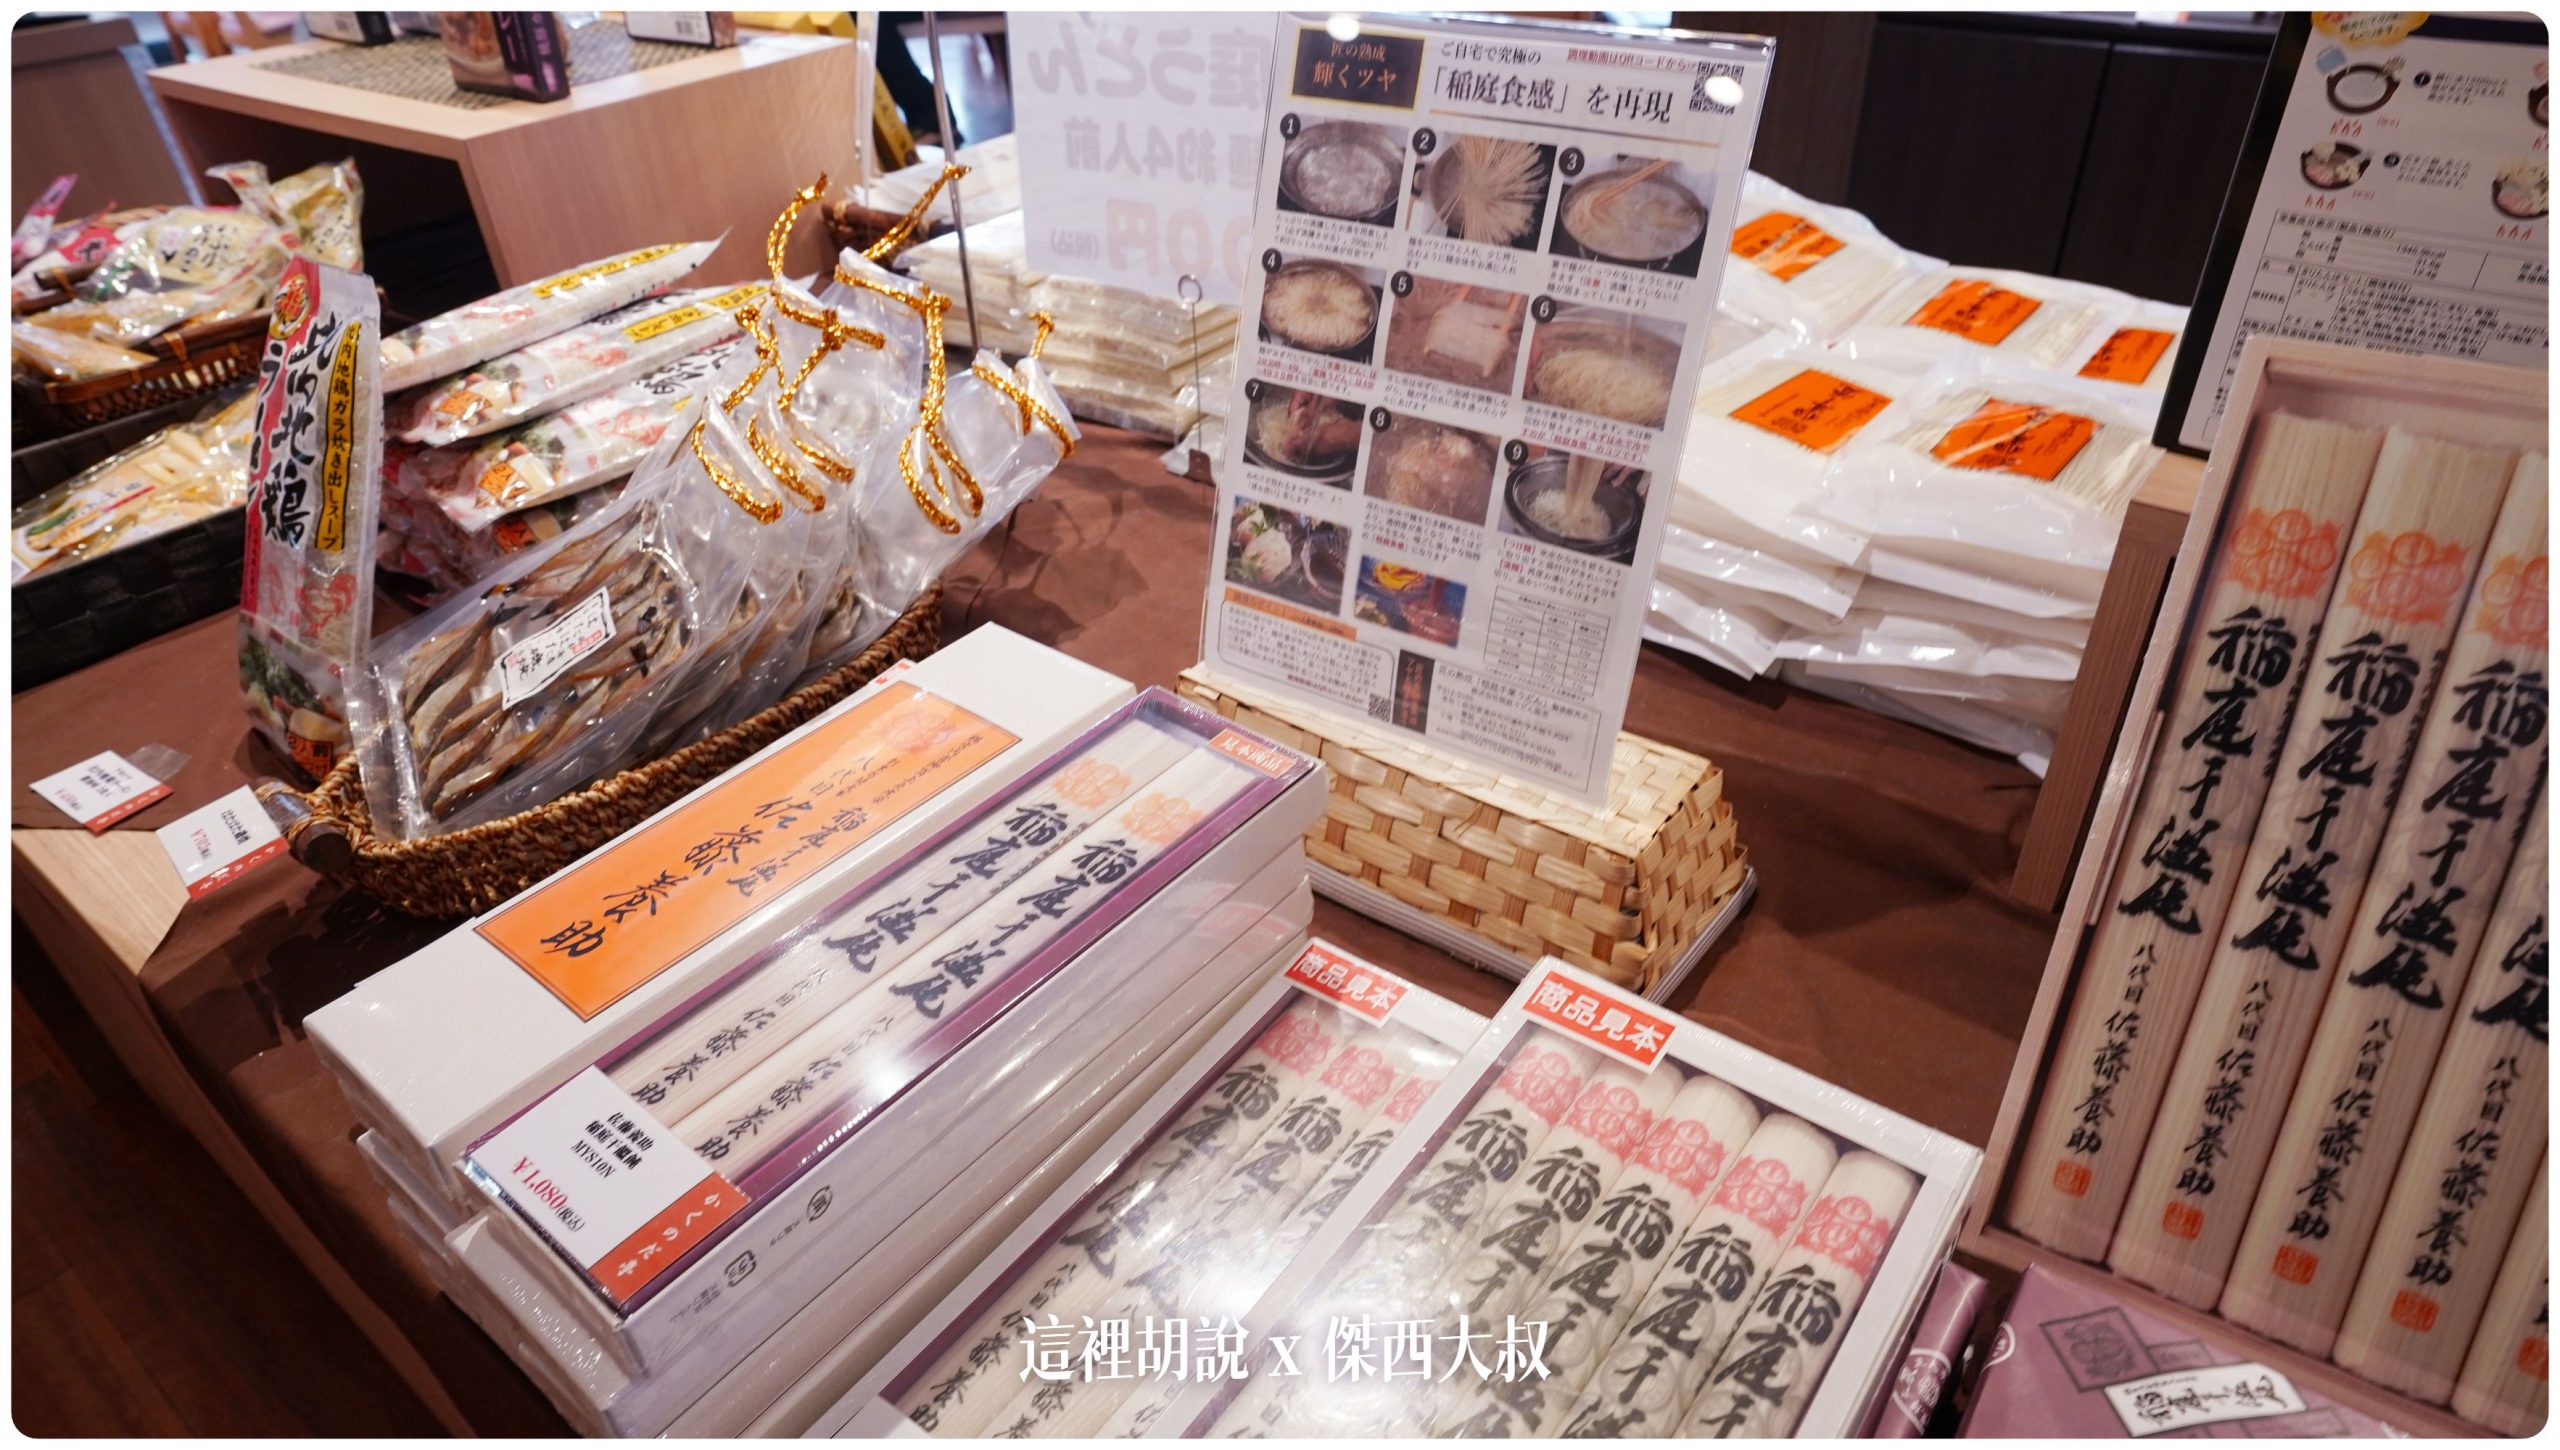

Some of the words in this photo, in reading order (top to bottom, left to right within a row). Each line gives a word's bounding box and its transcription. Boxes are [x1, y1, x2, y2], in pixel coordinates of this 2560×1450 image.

[1312, 60, 1397, 92] 輝くツヤ
[1440, 41, 1542, 65] ご自宅で究極の
[1296, 949, 1398, 1012] 商品見本
[1531, 980, 1666, 1055] 商品見本
